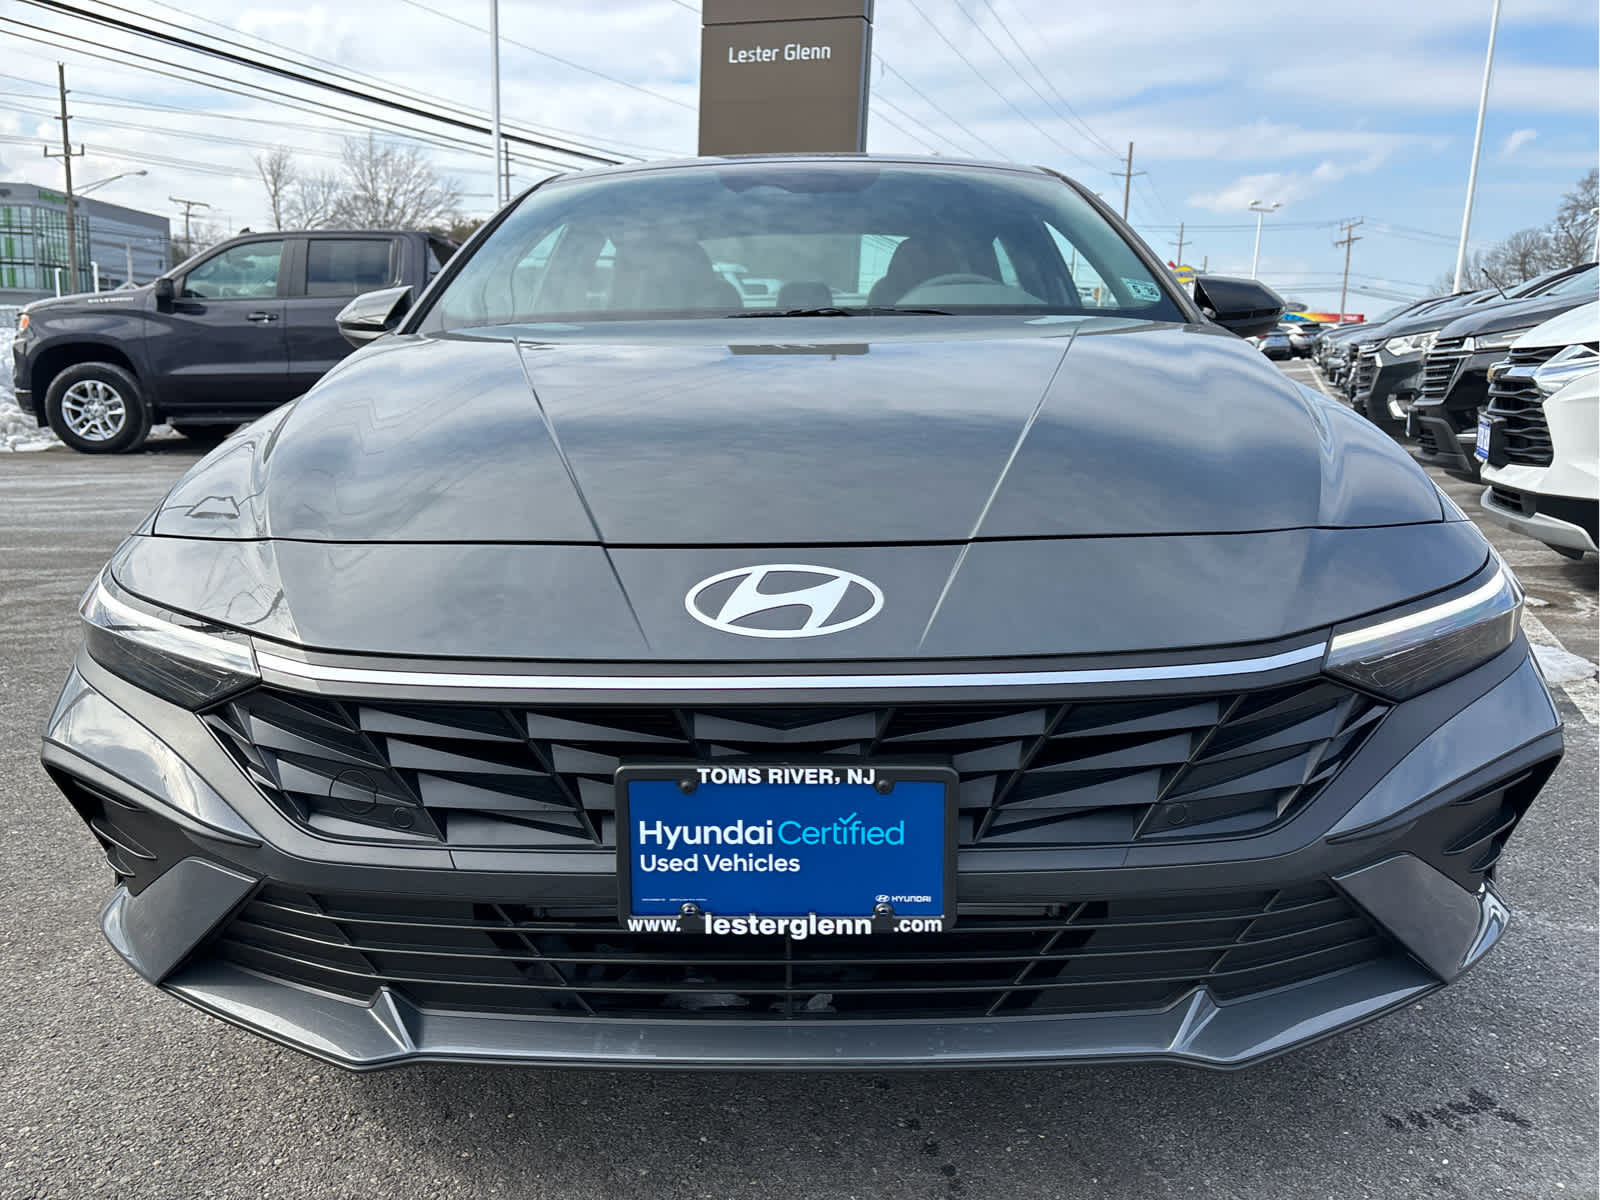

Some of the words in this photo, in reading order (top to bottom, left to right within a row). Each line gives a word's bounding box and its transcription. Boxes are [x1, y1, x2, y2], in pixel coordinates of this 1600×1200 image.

[728, 46, 780, 64] Lester
[783, 43, 832, 61] Glenn
[697, 768, 762, 785] TOMS
[768, 768, 841, 785] RIVER,
[847, 768, 876, 785] NJ
[639, 819, 773, 850] Hyundai
[777, 812, 905, 846] Certified
[640, 853, 699, 873] Used
[703, 853, 801, 873] Vehicles
[891, 895, 932, 903] HYUNDAI
[627, 919, 681, 932] www.
[704, 912, 872, 940] lesterglenn
[893, 919, 943, 933] .com
